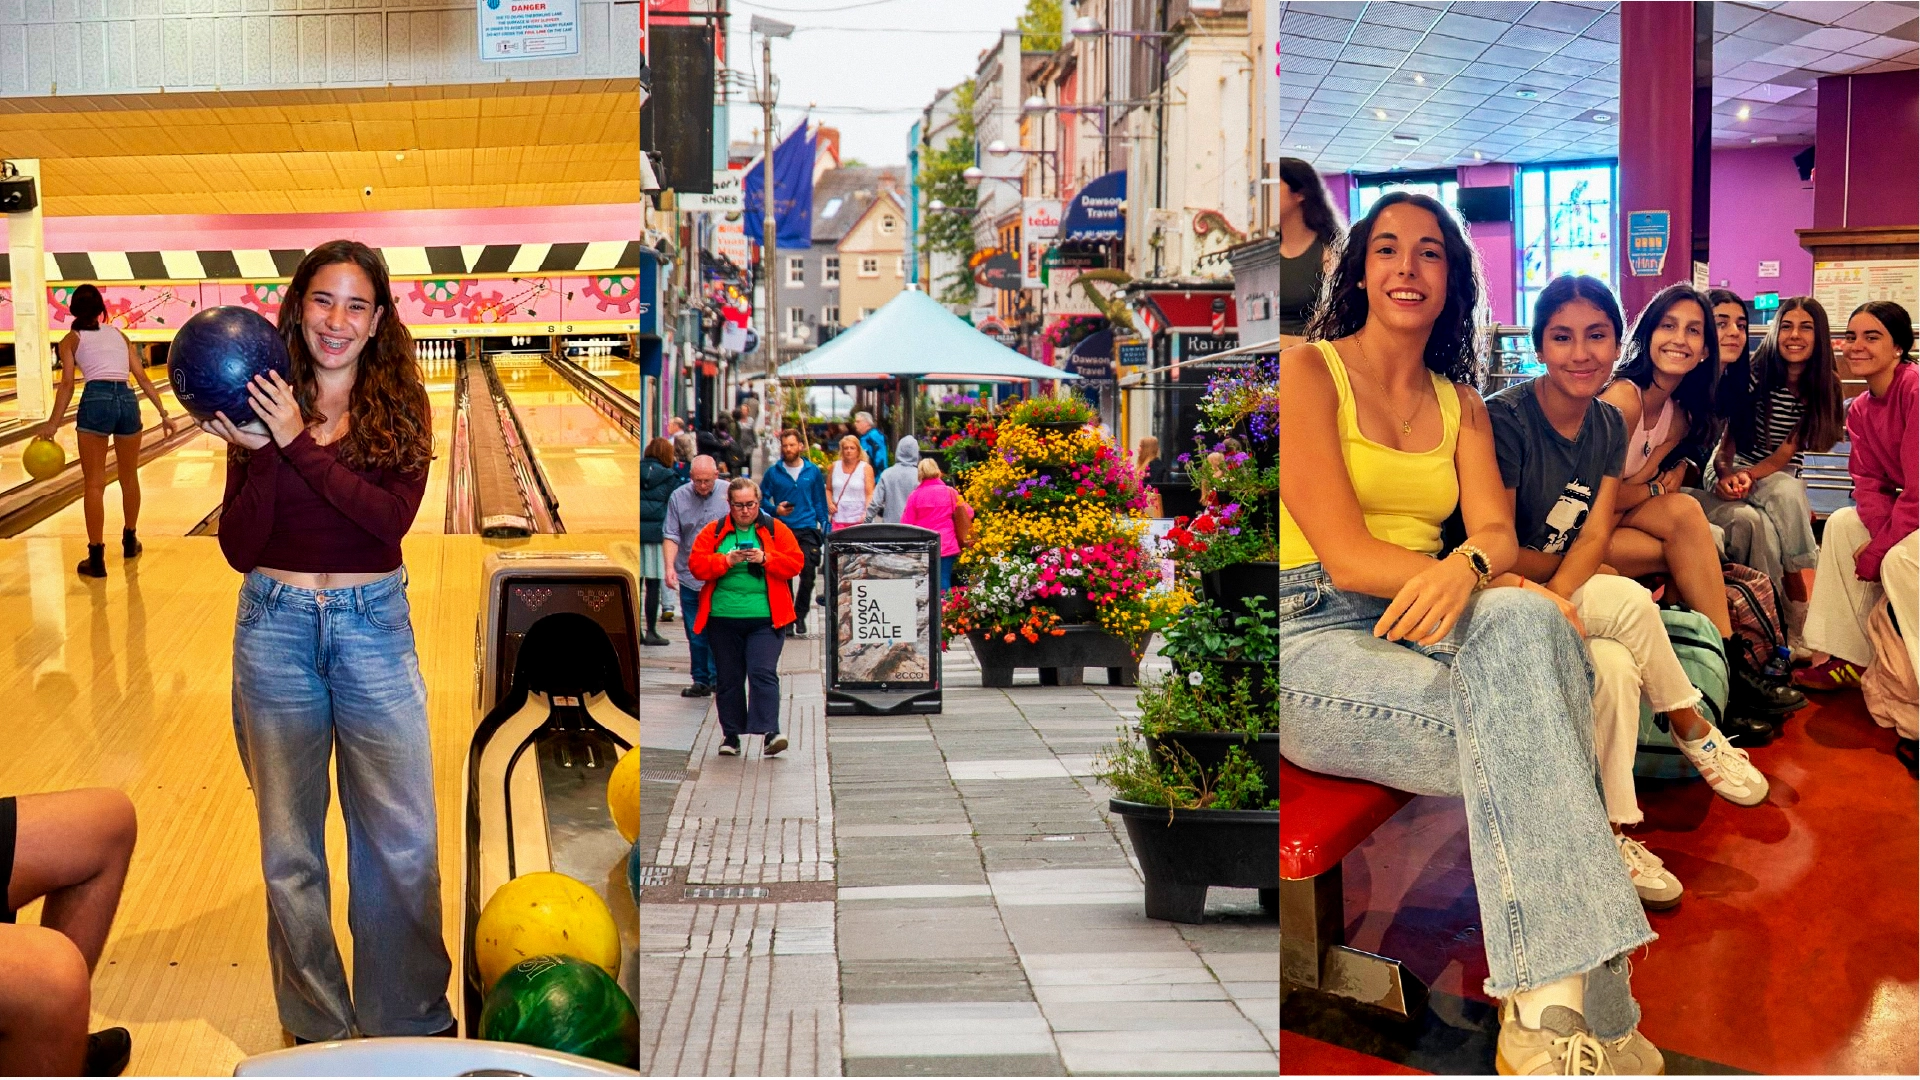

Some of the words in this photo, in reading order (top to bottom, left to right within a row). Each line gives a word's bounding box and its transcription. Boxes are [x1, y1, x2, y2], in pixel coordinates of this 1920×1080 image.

[511, 3, 546, 12] DANGER
[701, 195, 738, 204] SHOES
[1081, 195, 1122, 207] Dawson
[1086, 208, 1118, 219] Travel
[1071, 354, 1110, 365] Dawson
[1077, 366, 1106, 376] Travel
[857, 585, 867, 599] S
[857, 599, 881, 613] SA
[858, 611, 891, 625] SAL
[858, 625, 902, 640] SALE
[895, 671, 924, 680] ecco
